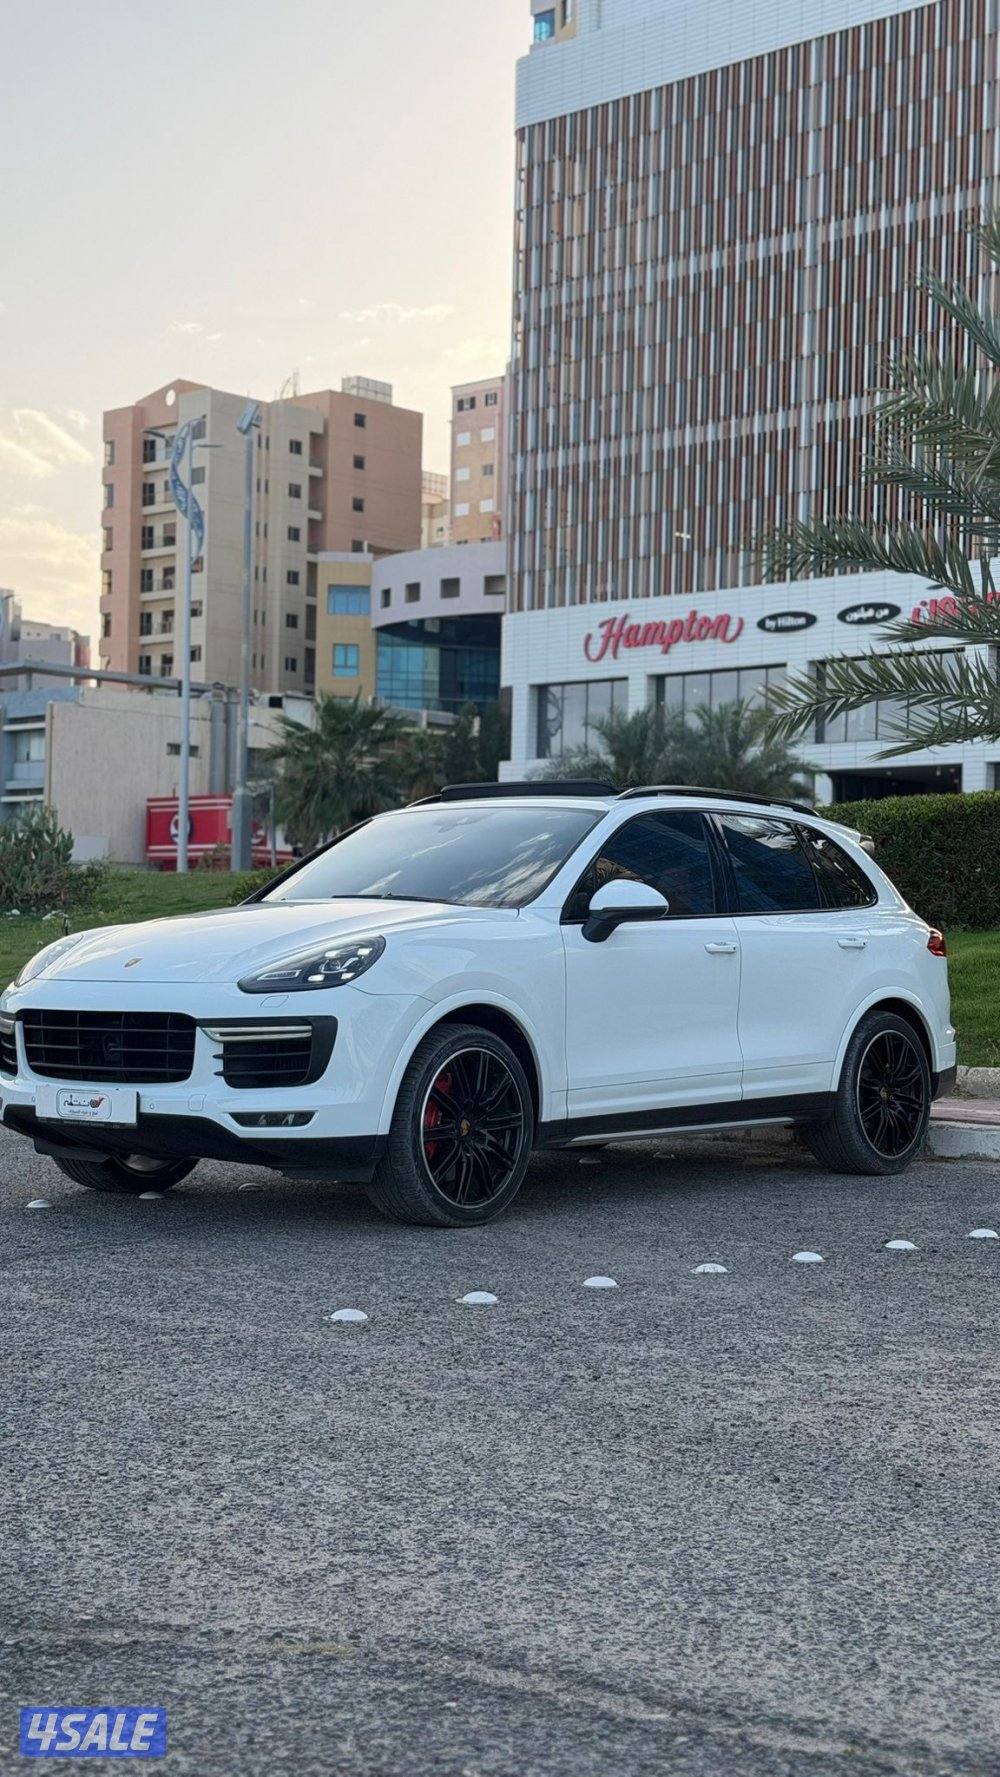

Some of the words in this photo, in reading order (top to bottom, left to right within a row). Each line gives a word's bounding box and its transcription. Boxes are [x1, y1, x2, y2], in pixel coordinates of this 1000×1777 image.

[584, 609, 744, 662] Hampton
[765, 618, 776, 631] by
[777, 615, 806, 628] Hilton
